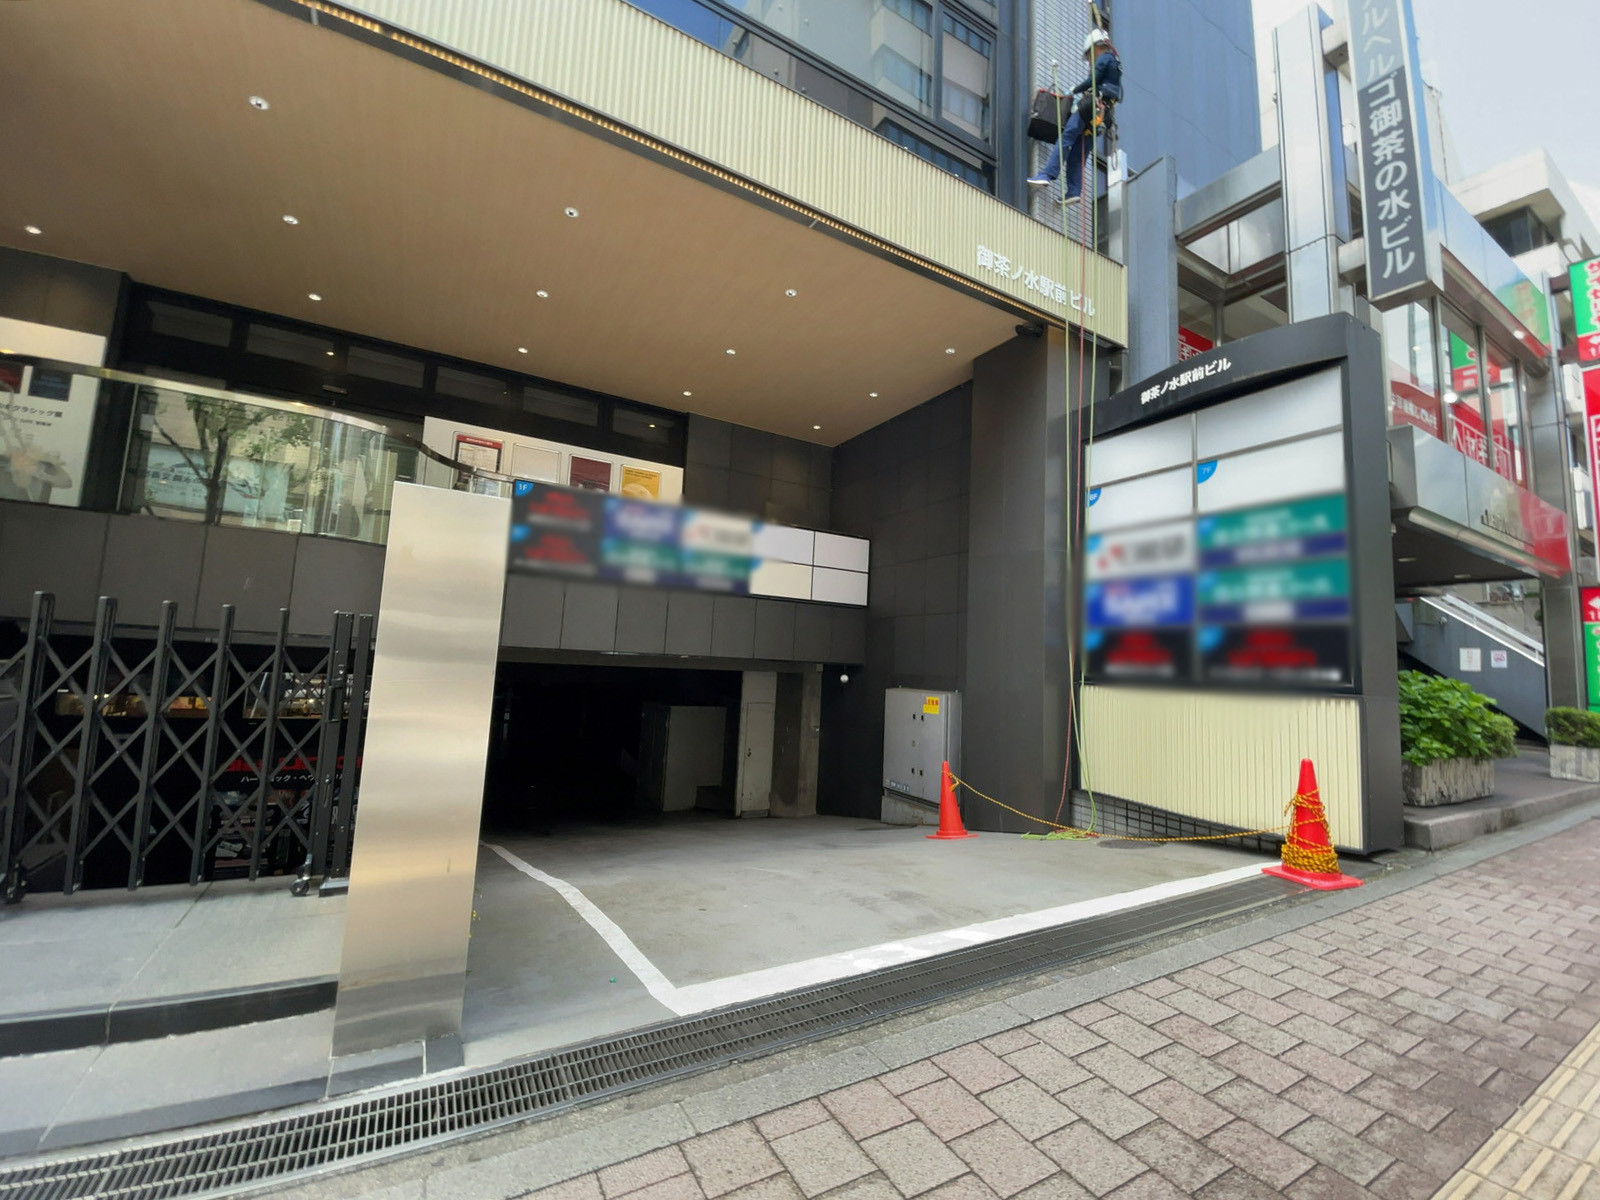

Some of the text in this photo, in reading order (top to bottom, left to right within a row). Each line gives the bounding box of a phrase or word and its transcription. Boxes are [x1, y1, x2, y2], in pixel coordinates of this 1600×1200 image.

[1361, 0, 1416, 279] ルヘルゴ御茶の水ビル
[1140, 357, 1232, 405] 御茶ノ水駅前ビル
[518, 483, 529, 492] 1F
